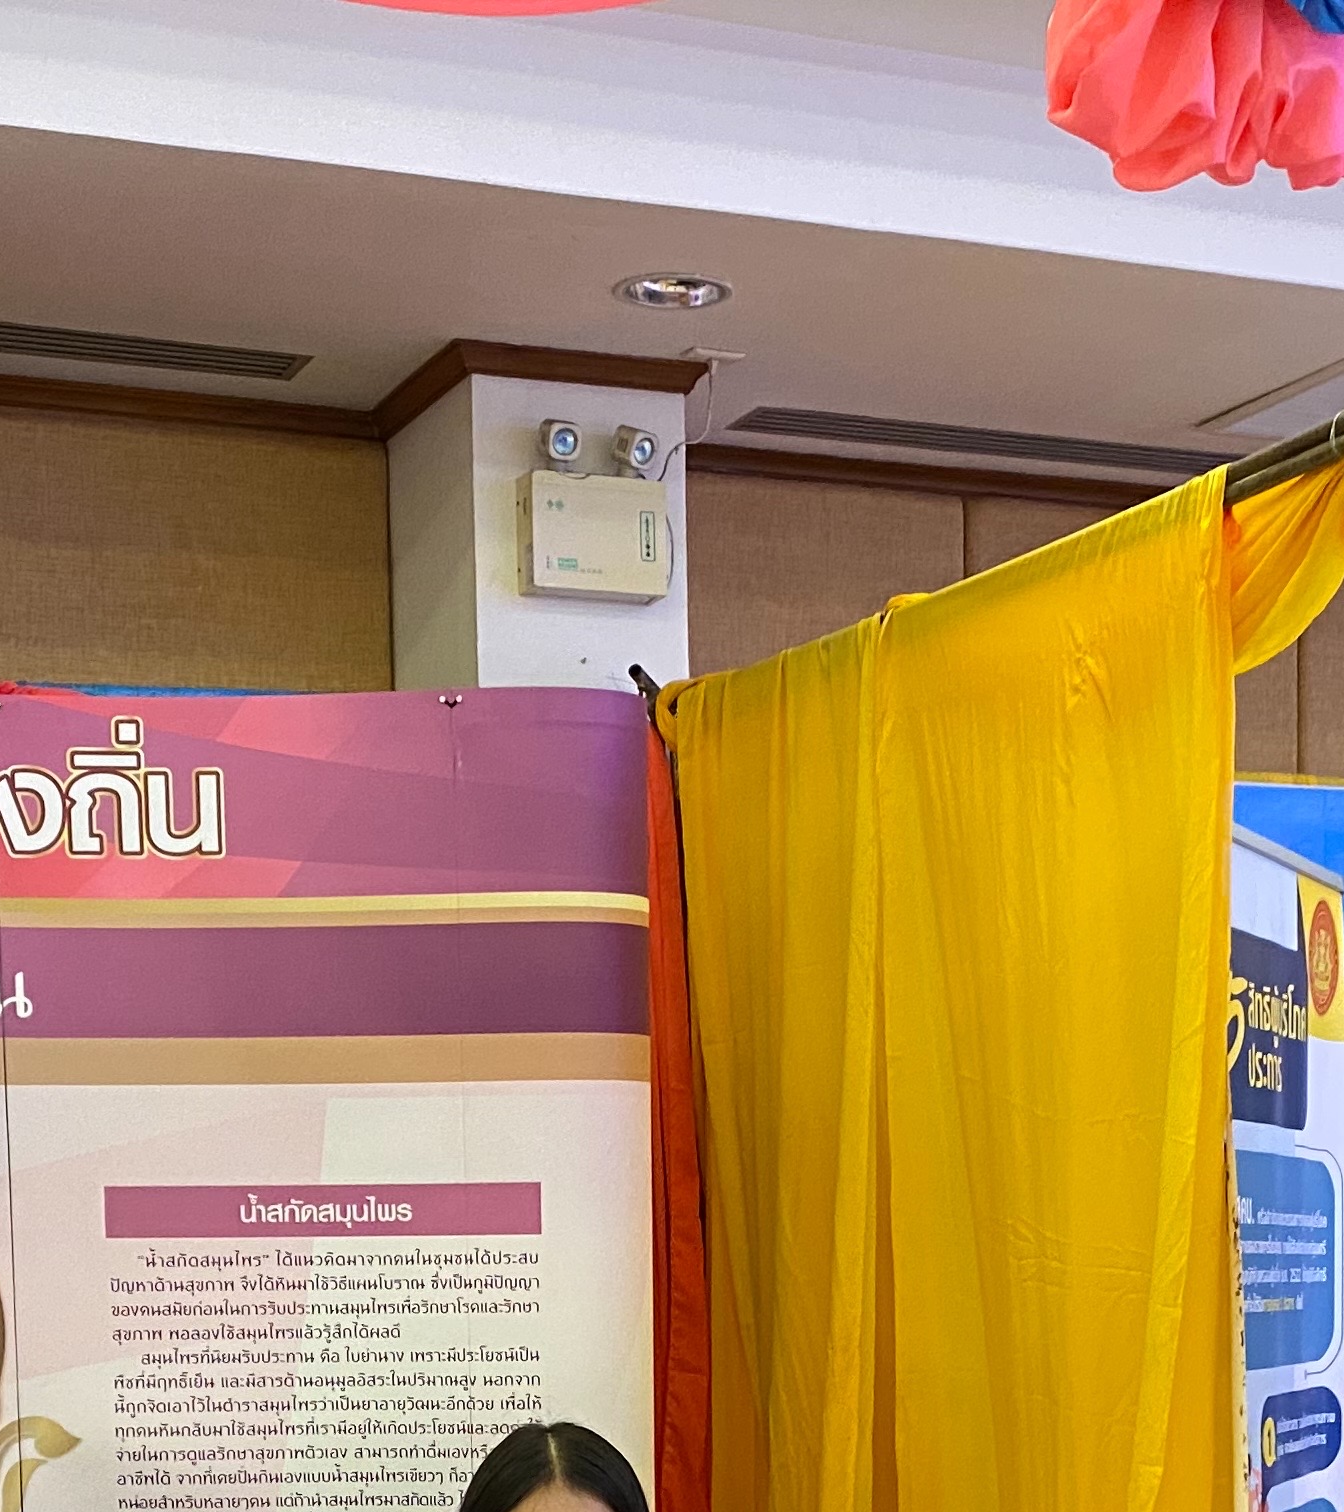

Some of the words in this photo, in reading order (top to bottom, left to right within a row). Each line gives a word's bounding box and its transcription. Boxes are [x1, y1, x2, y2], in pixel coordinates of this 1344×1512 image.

[239, 1193, 413, 1229] น้ำสกัดสมุนไพร
[111, 1327, 163, 1346] สุขภาพ
[320, 1346, 340, 1364] คือ
[483, 1373, 542, 1387] นอกจาก
[354, 1440, 493, 1460] สามารถทำดื่มเองหรื
[116, 1468, 171, 1486] อาชีพได้
